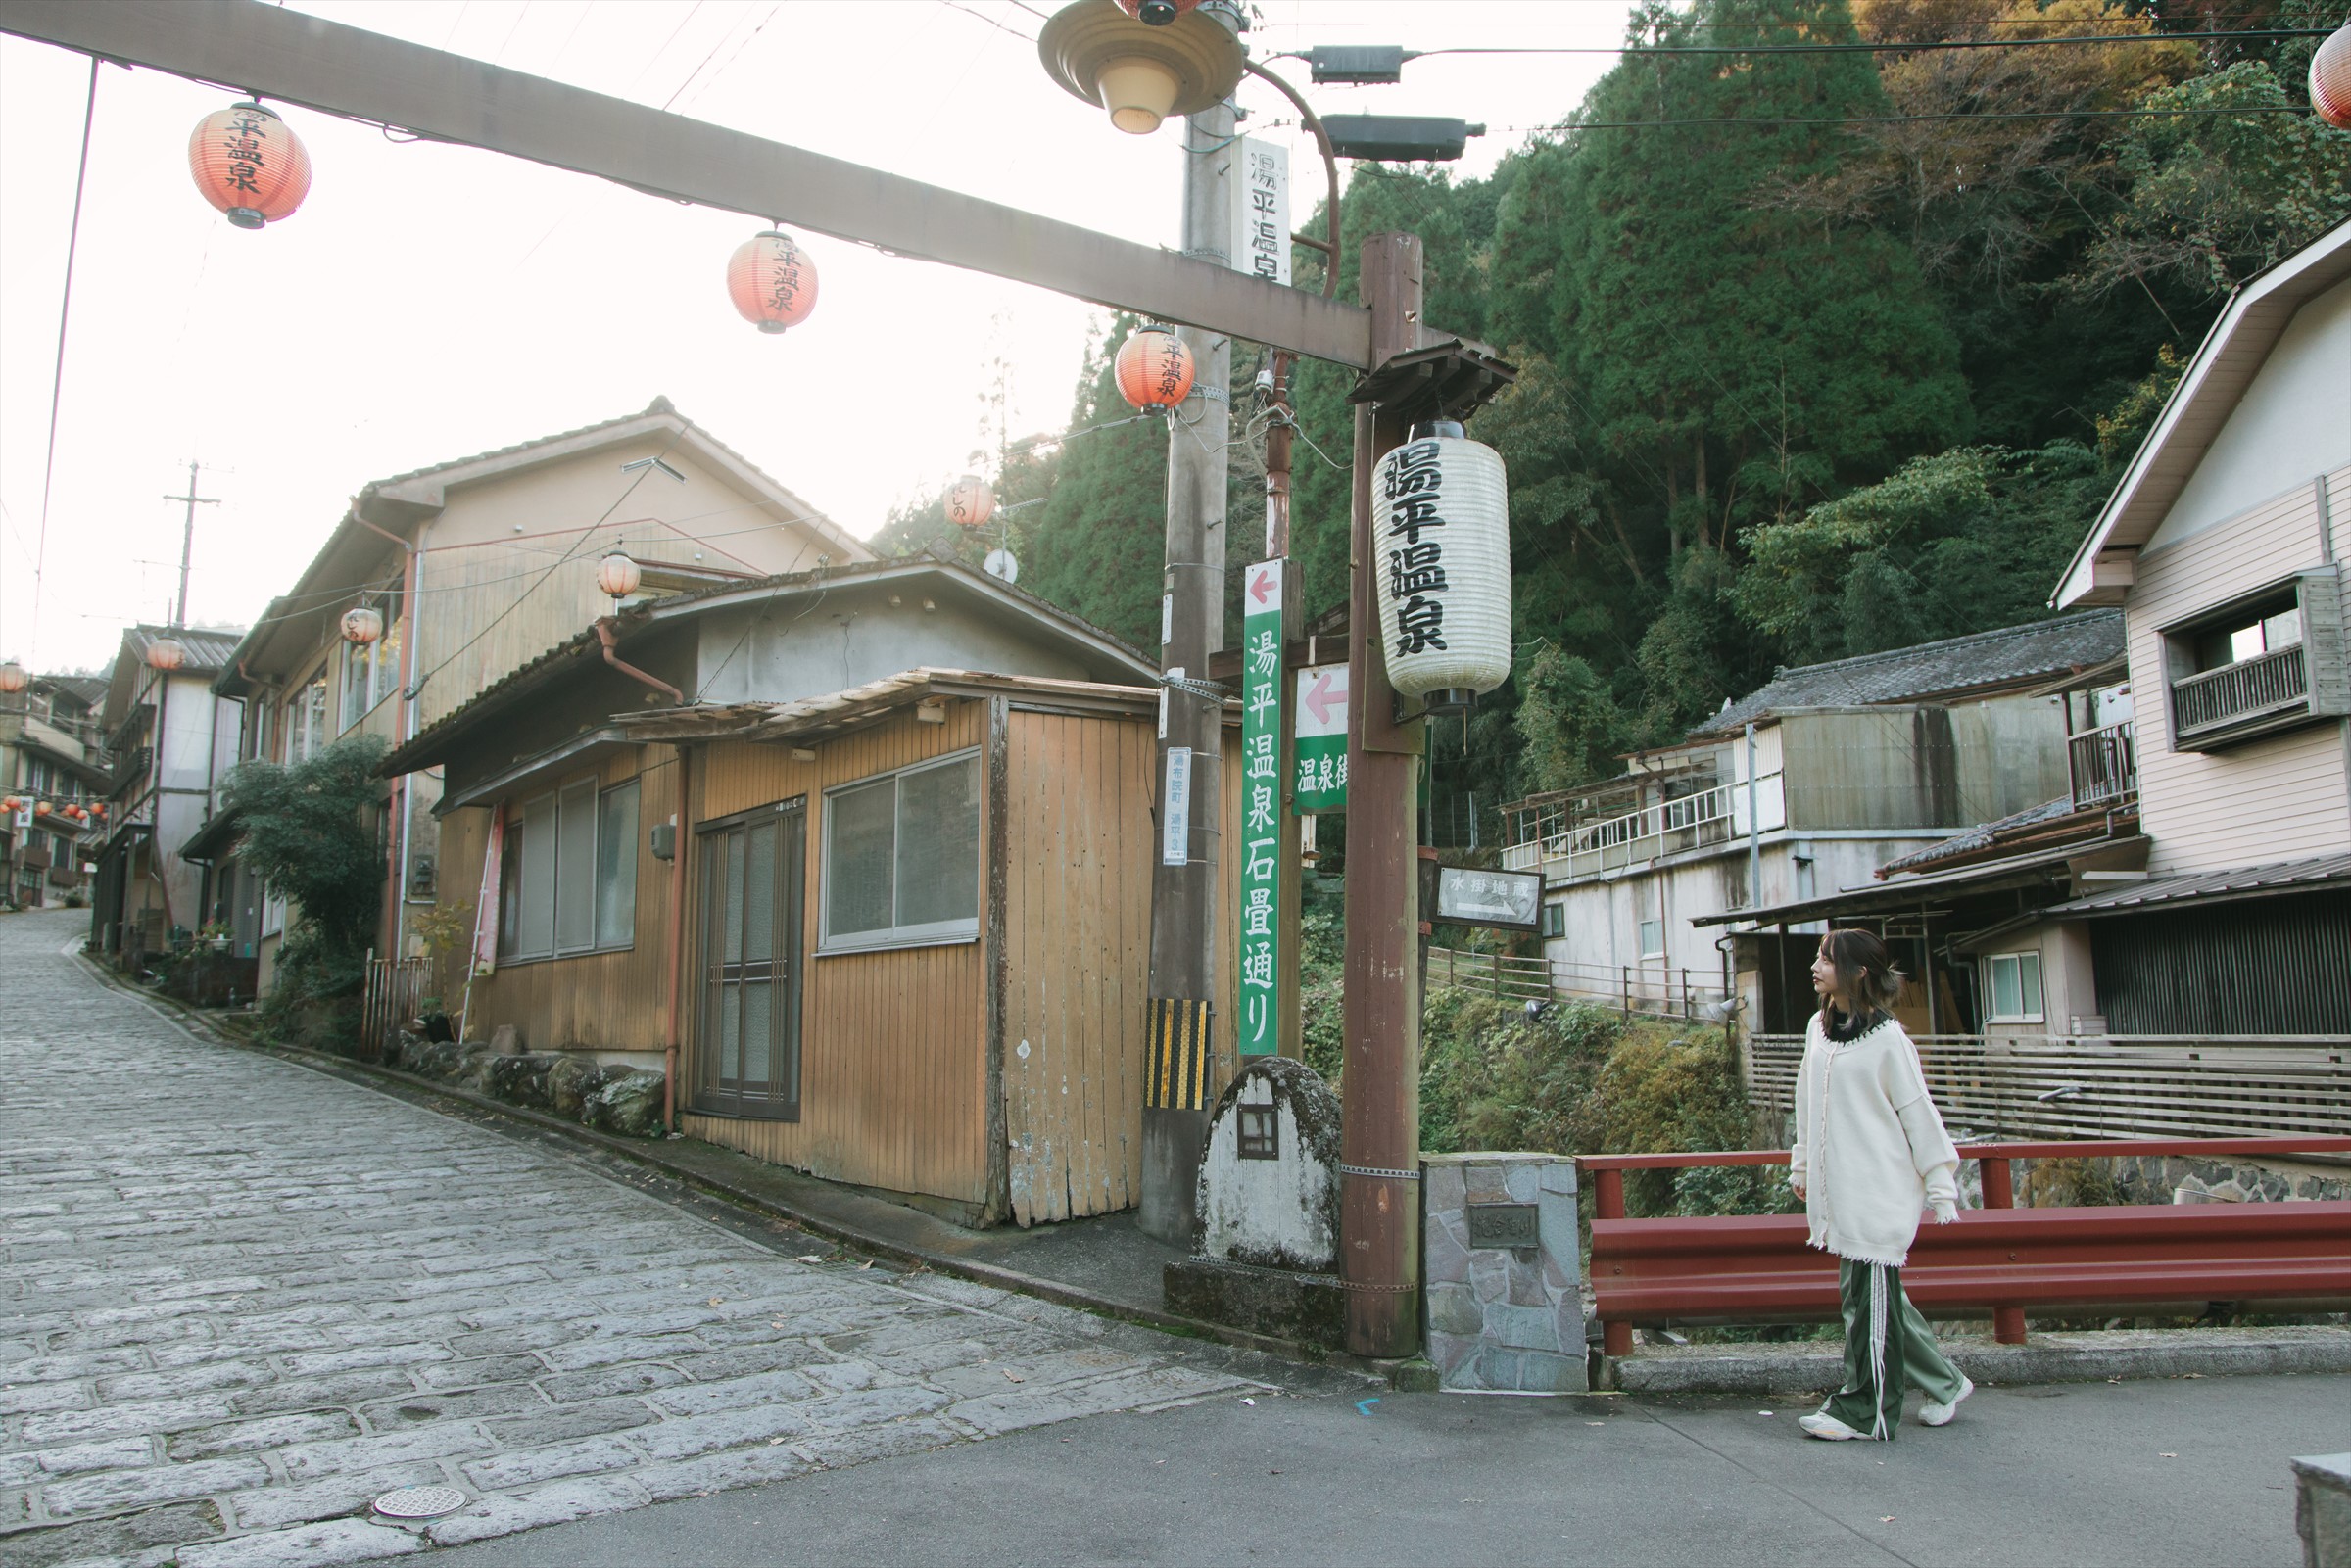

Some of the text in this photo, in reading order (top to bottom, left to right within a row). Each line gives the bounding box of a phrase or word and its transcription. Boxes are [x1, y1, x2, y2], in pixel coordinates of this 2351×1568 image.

[1384, 442, 1449, 658] 湯平温泉
[1171, 755, 1184, 804] 湯布院町
[1170, 814, 1181, 851] 湯平3
[1243, 629, 1278, 1042] 湯平温泉石畳通り
[1450, 876, 1530, 898] 水掛地蔵
